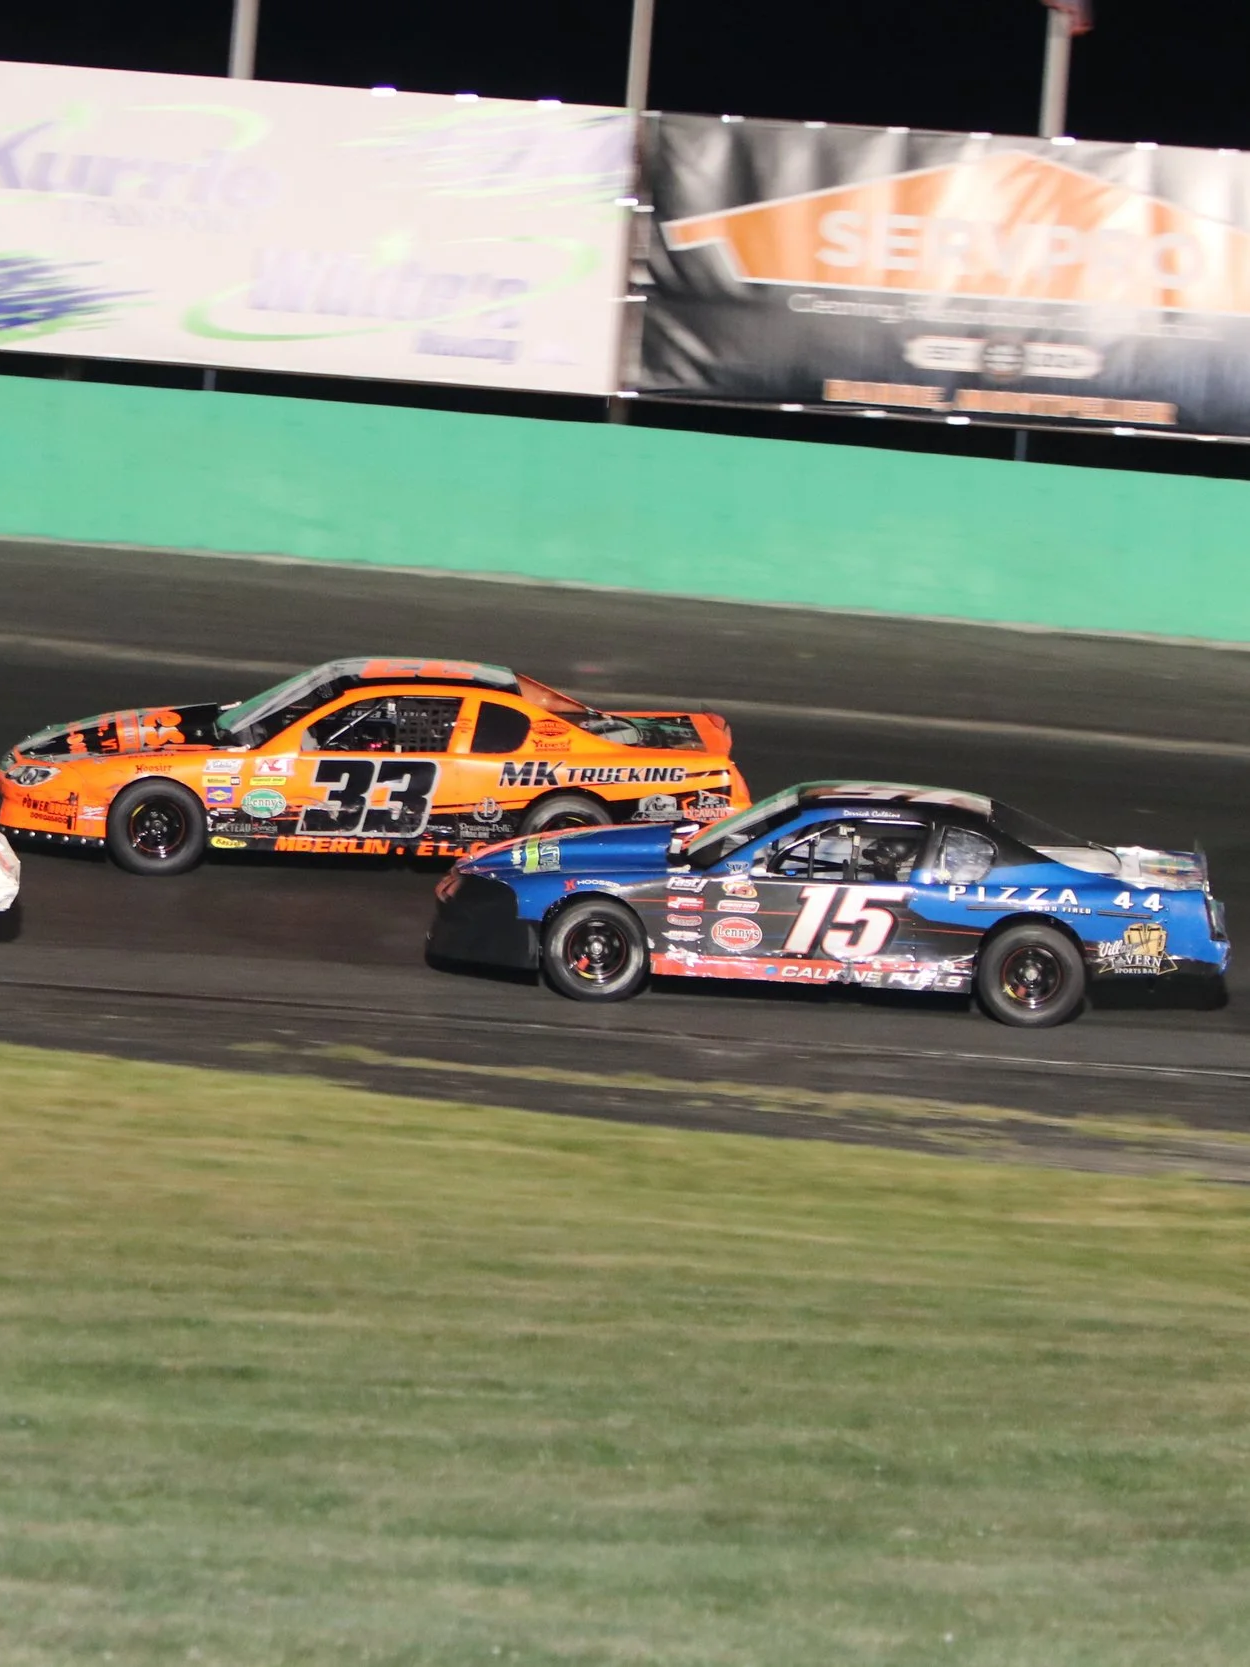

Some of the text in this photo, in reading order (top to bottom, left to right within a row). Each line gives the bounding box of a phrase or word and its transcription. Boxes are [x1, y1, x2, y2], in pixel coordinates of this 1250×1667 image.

[499, 761, 686, 787] MK TRUCKING
[295, 757, 441, 838] 33
[948, 885, 1164, 912] PIZZA 44
[716, 924, 760, 941] Lenny's
[782, 885, 910, 960] 15
[781, 966, 879, 983] CALKNS
